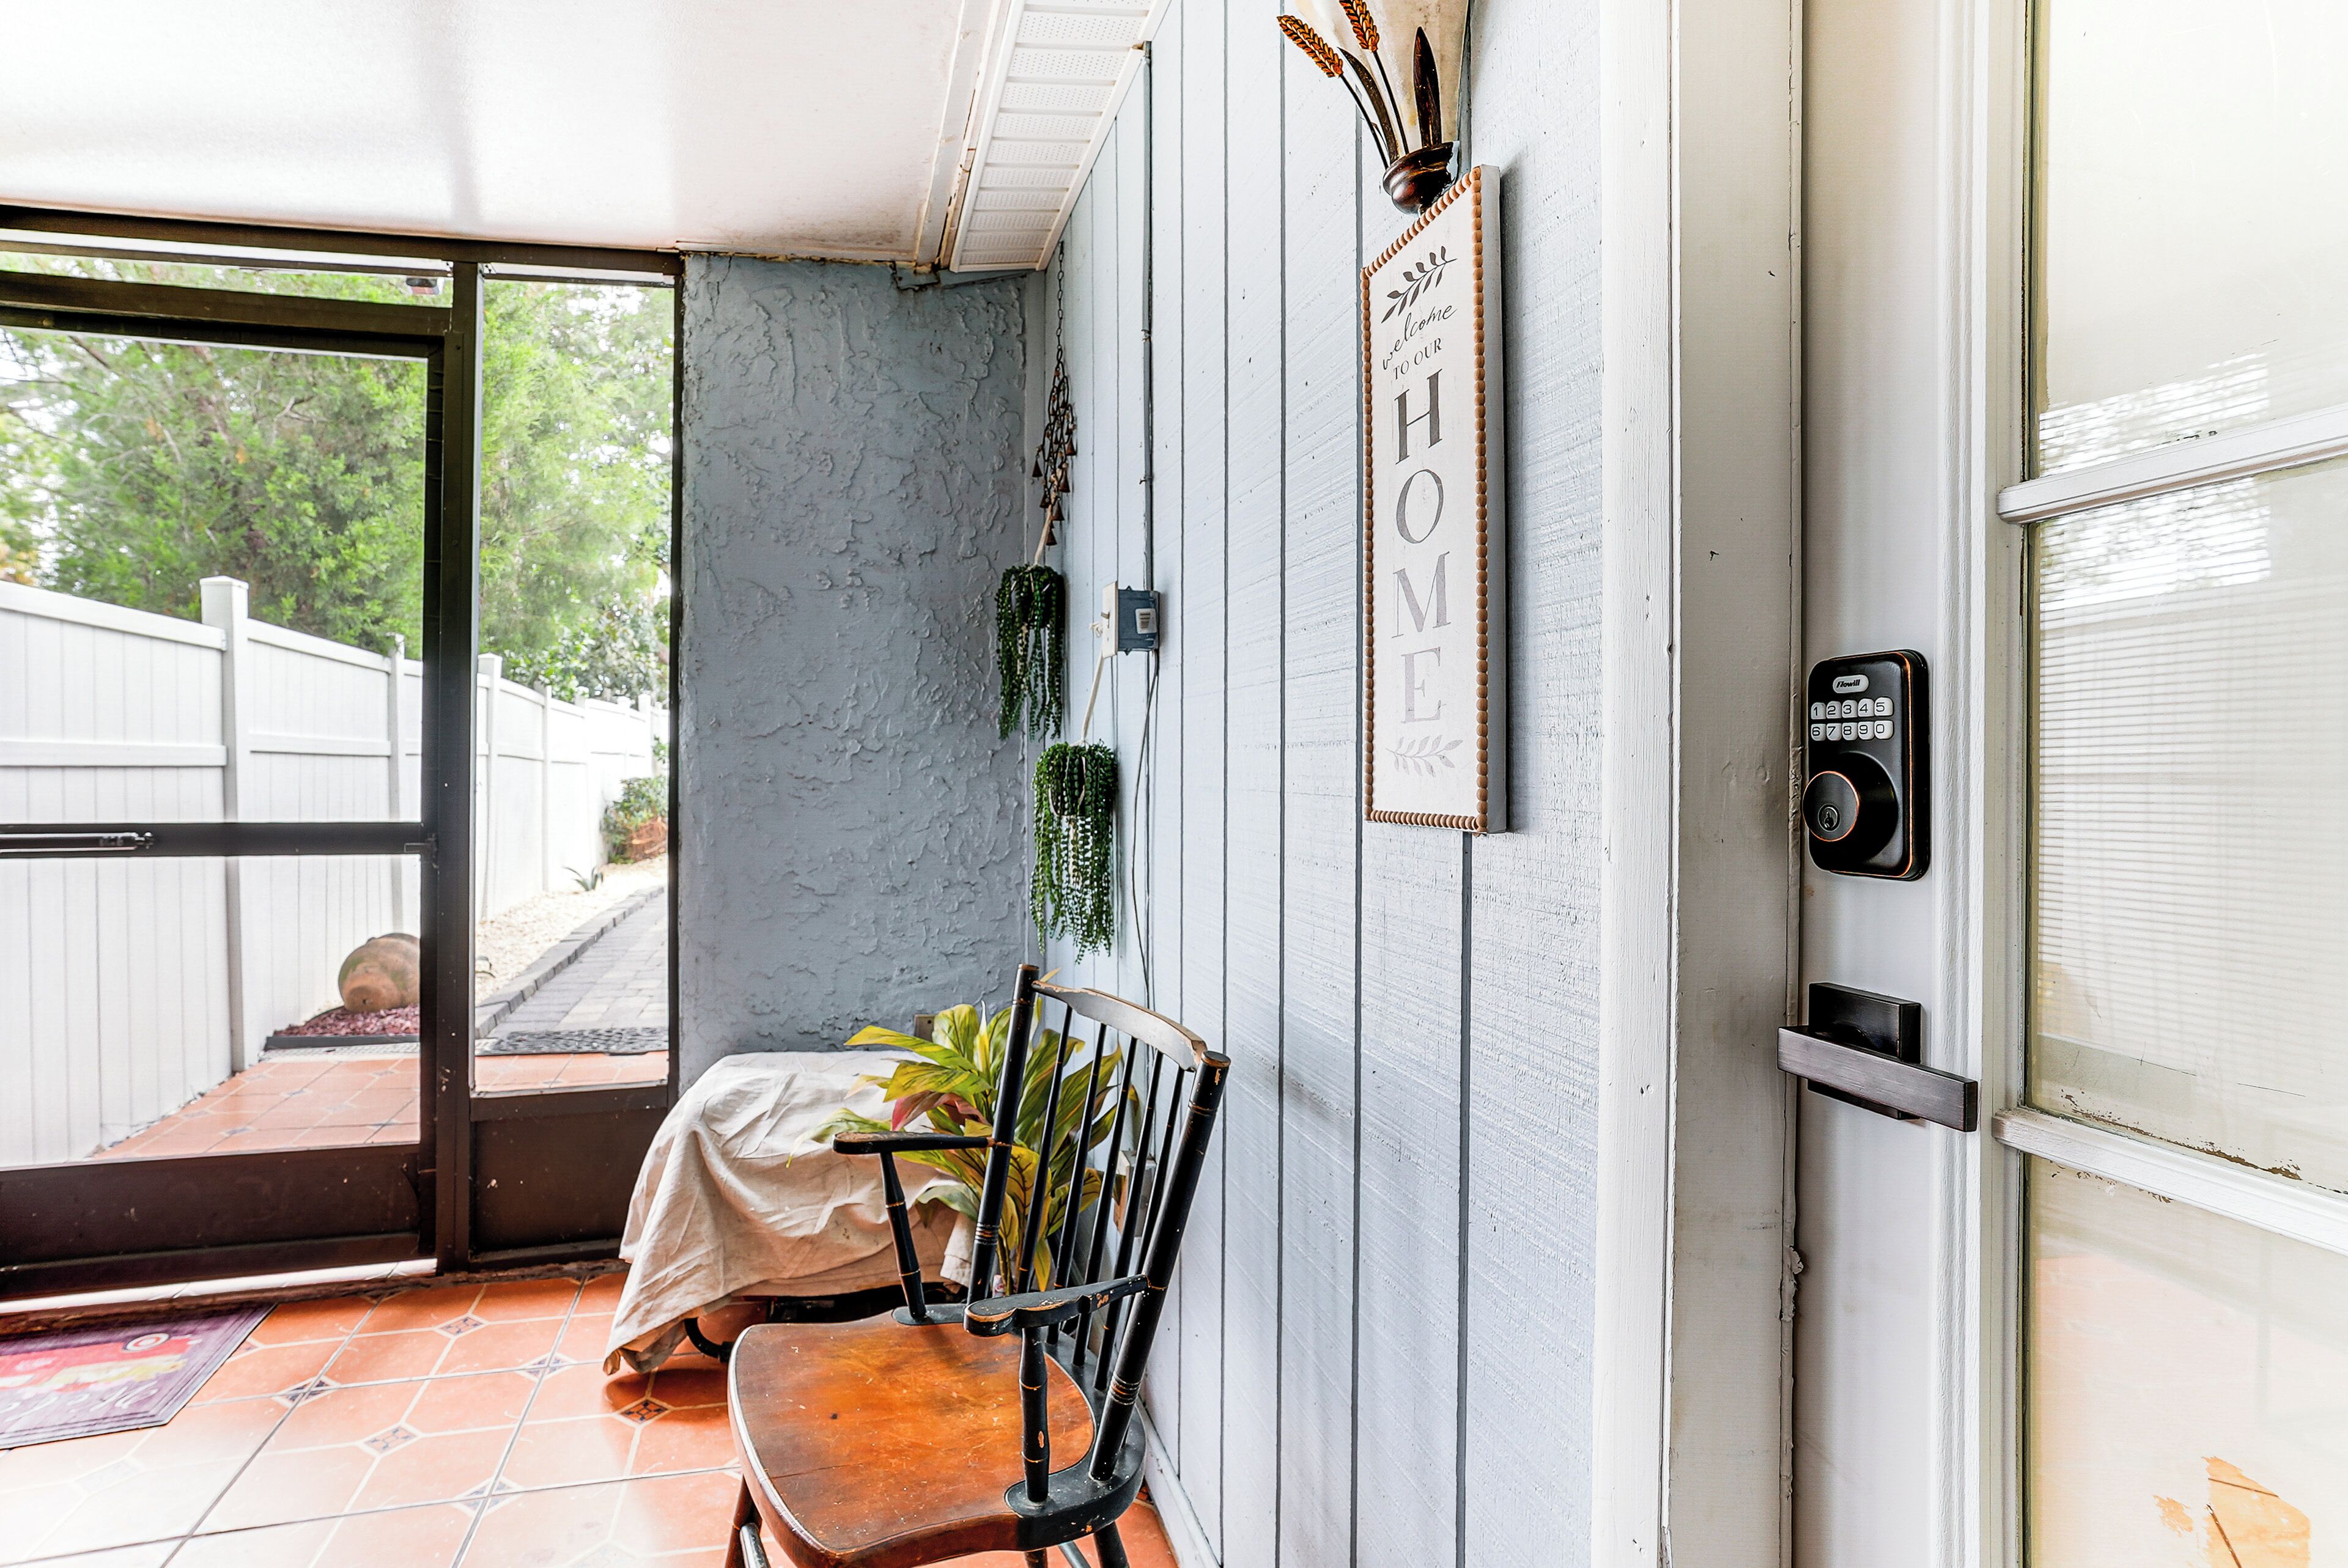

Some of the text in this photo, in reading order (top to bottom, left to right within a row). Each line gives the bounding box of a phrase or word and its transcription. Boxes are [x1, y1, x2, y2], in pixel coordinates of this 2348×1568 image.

[1393, 337, 1442, 380] TO OUR
[1392, 368, 1452, 724] HOME
